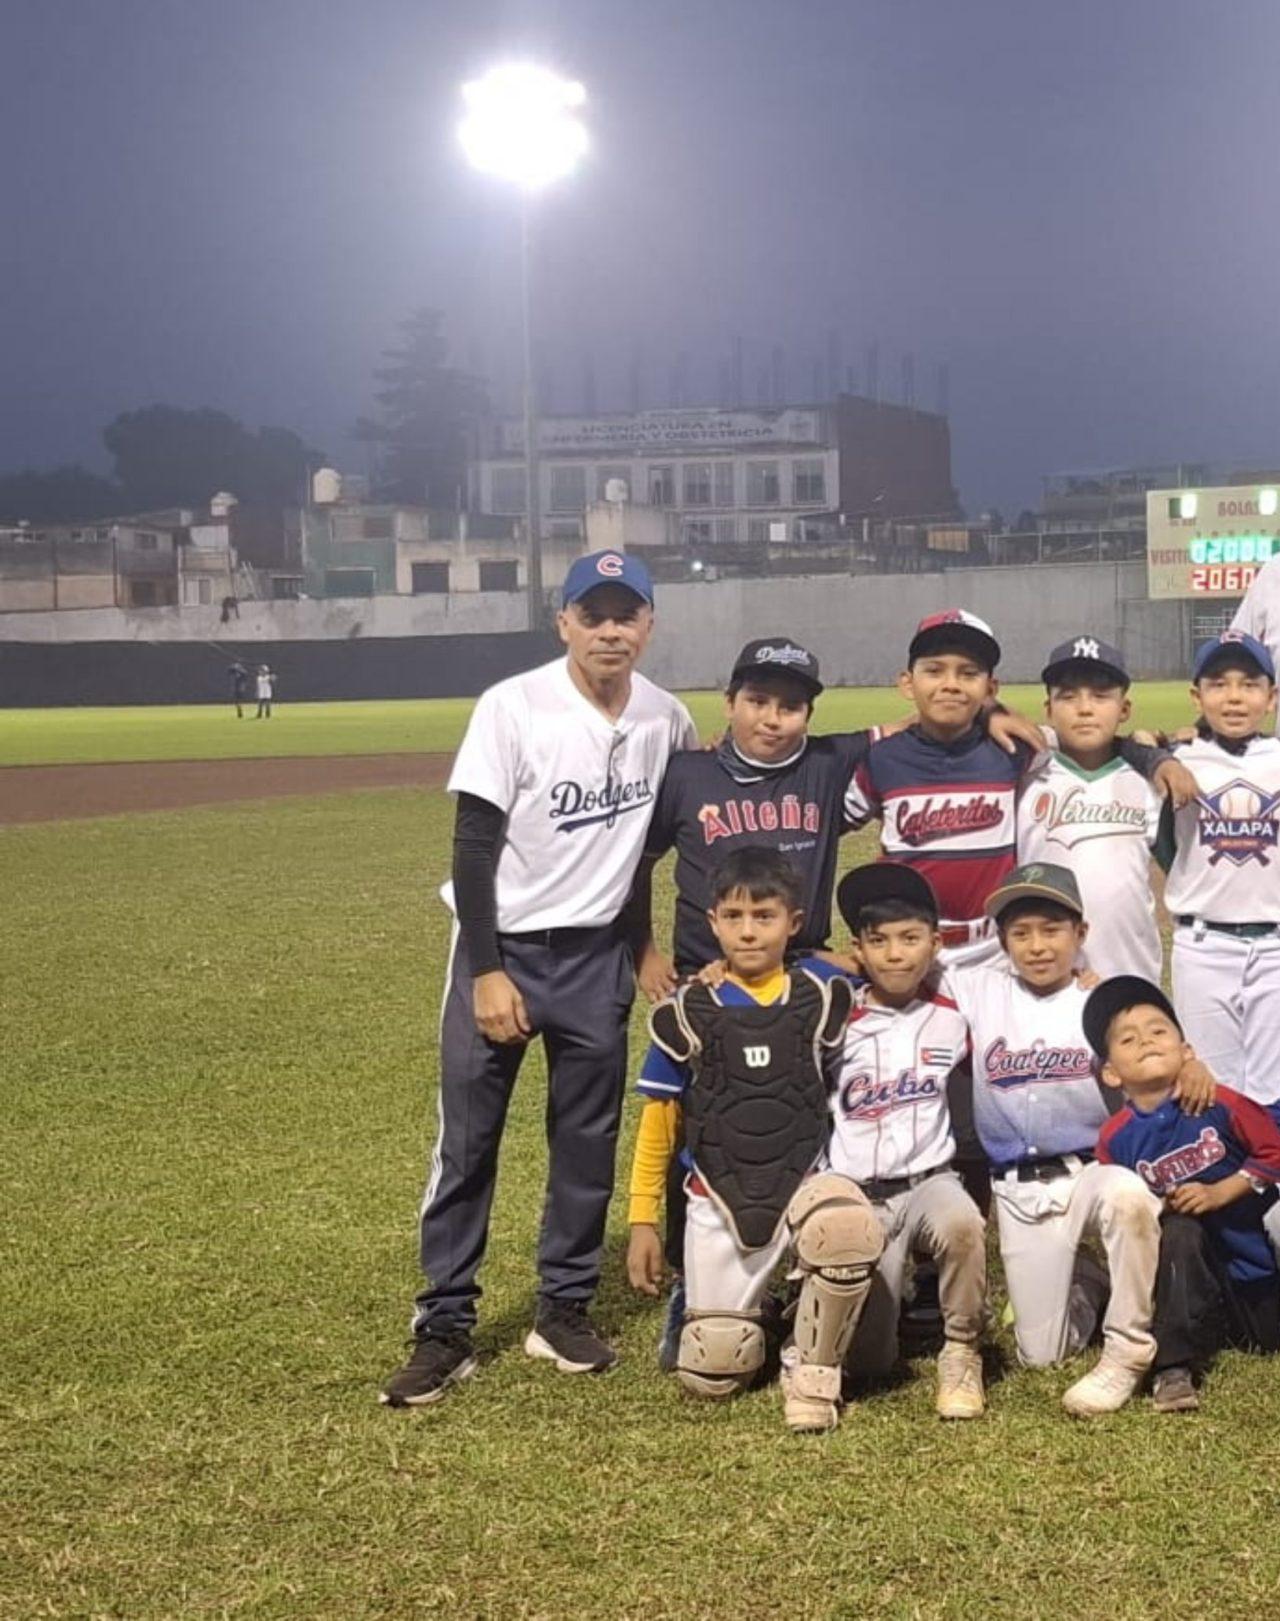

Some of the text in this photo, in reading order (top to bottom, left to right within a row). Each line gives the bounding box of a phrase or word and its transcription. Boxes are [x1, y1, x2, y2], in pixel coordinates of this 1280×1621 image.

[597, 554, 623, 577] C
[549, 778, 654, 832] Dodgers
[702, 793, 820, 846] Alteña
[1203, 821, 1274, 837] XALAPA
[983, 1036, 1090, 1081] Coatepec
[840, 1068, 940, 1112] Cubs
